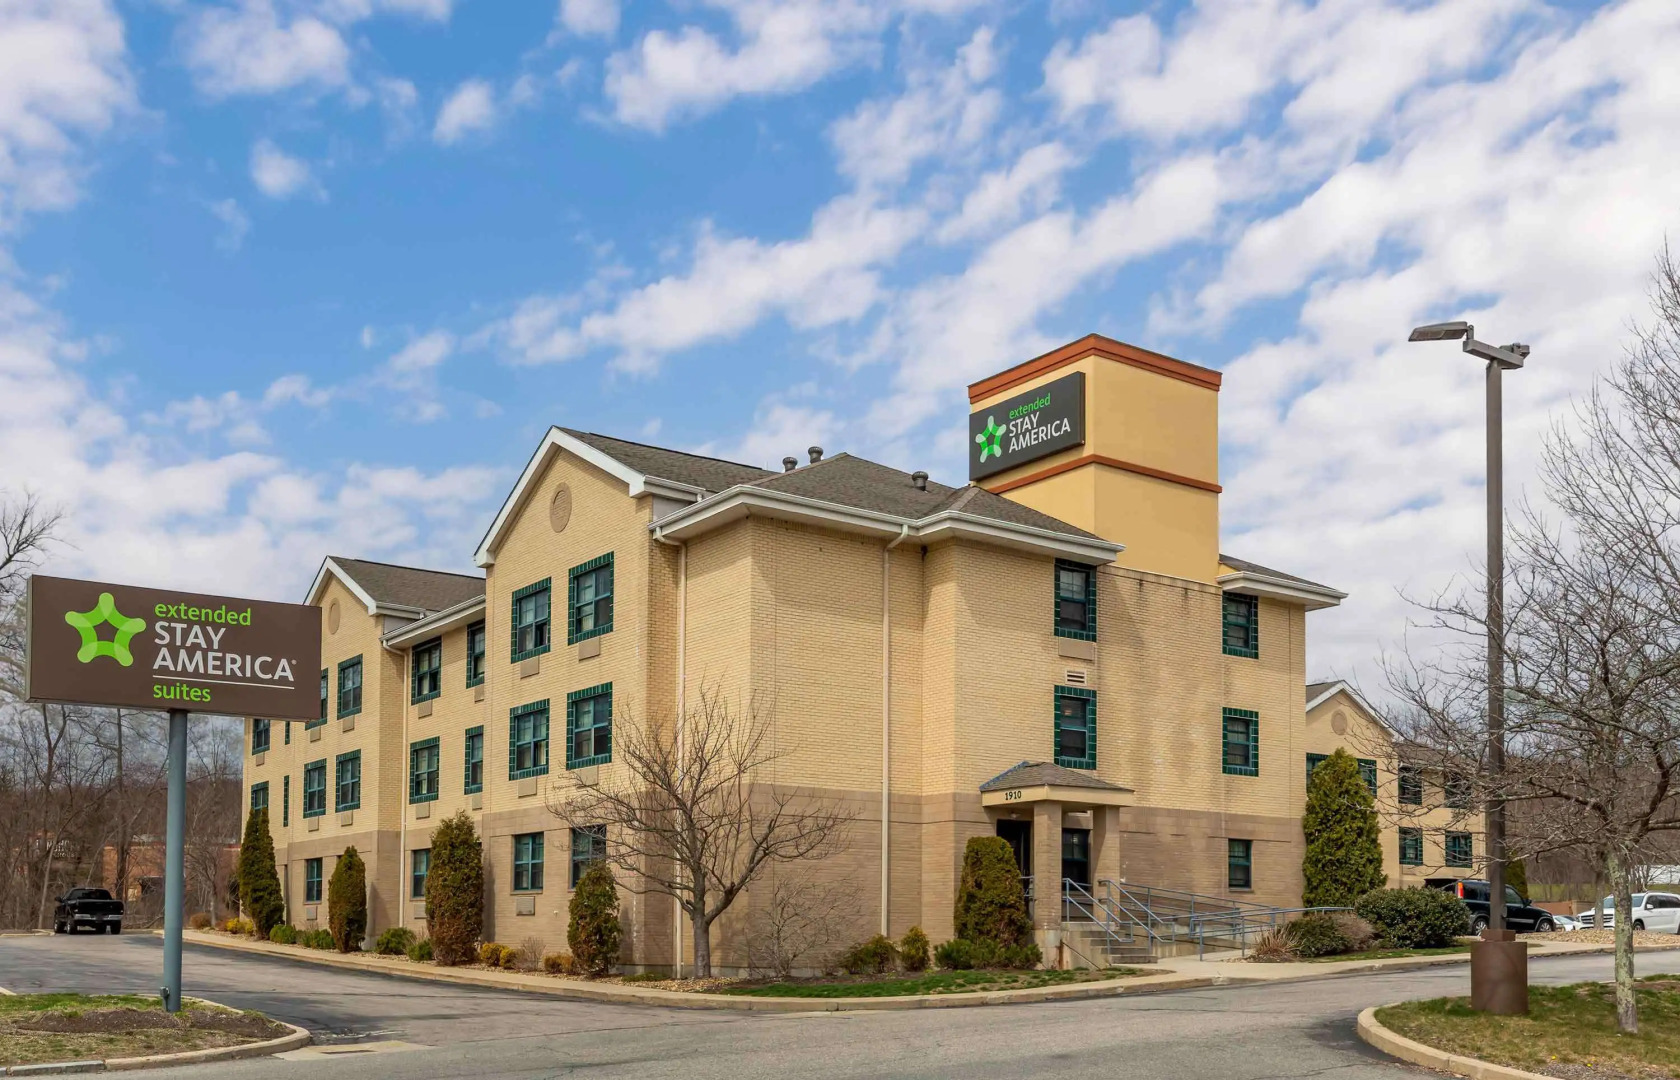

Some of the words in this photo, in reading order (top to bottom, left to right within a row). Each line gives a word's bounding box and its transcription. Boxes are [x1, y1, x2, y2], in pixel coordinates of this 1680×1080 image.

[1009, 392, 1051, 419] extended
[1009, 412, 1040, 437] STAY
[1009, 418, 1071, 453] AMERICA
[154, 602, 251, 626] extended
[154, 621, 226, 649] STAY
[152, 647, 295, 681] AMERICA
[153, 682, 211, 702] suites
[1005, 790, 1022, 801] 1910
